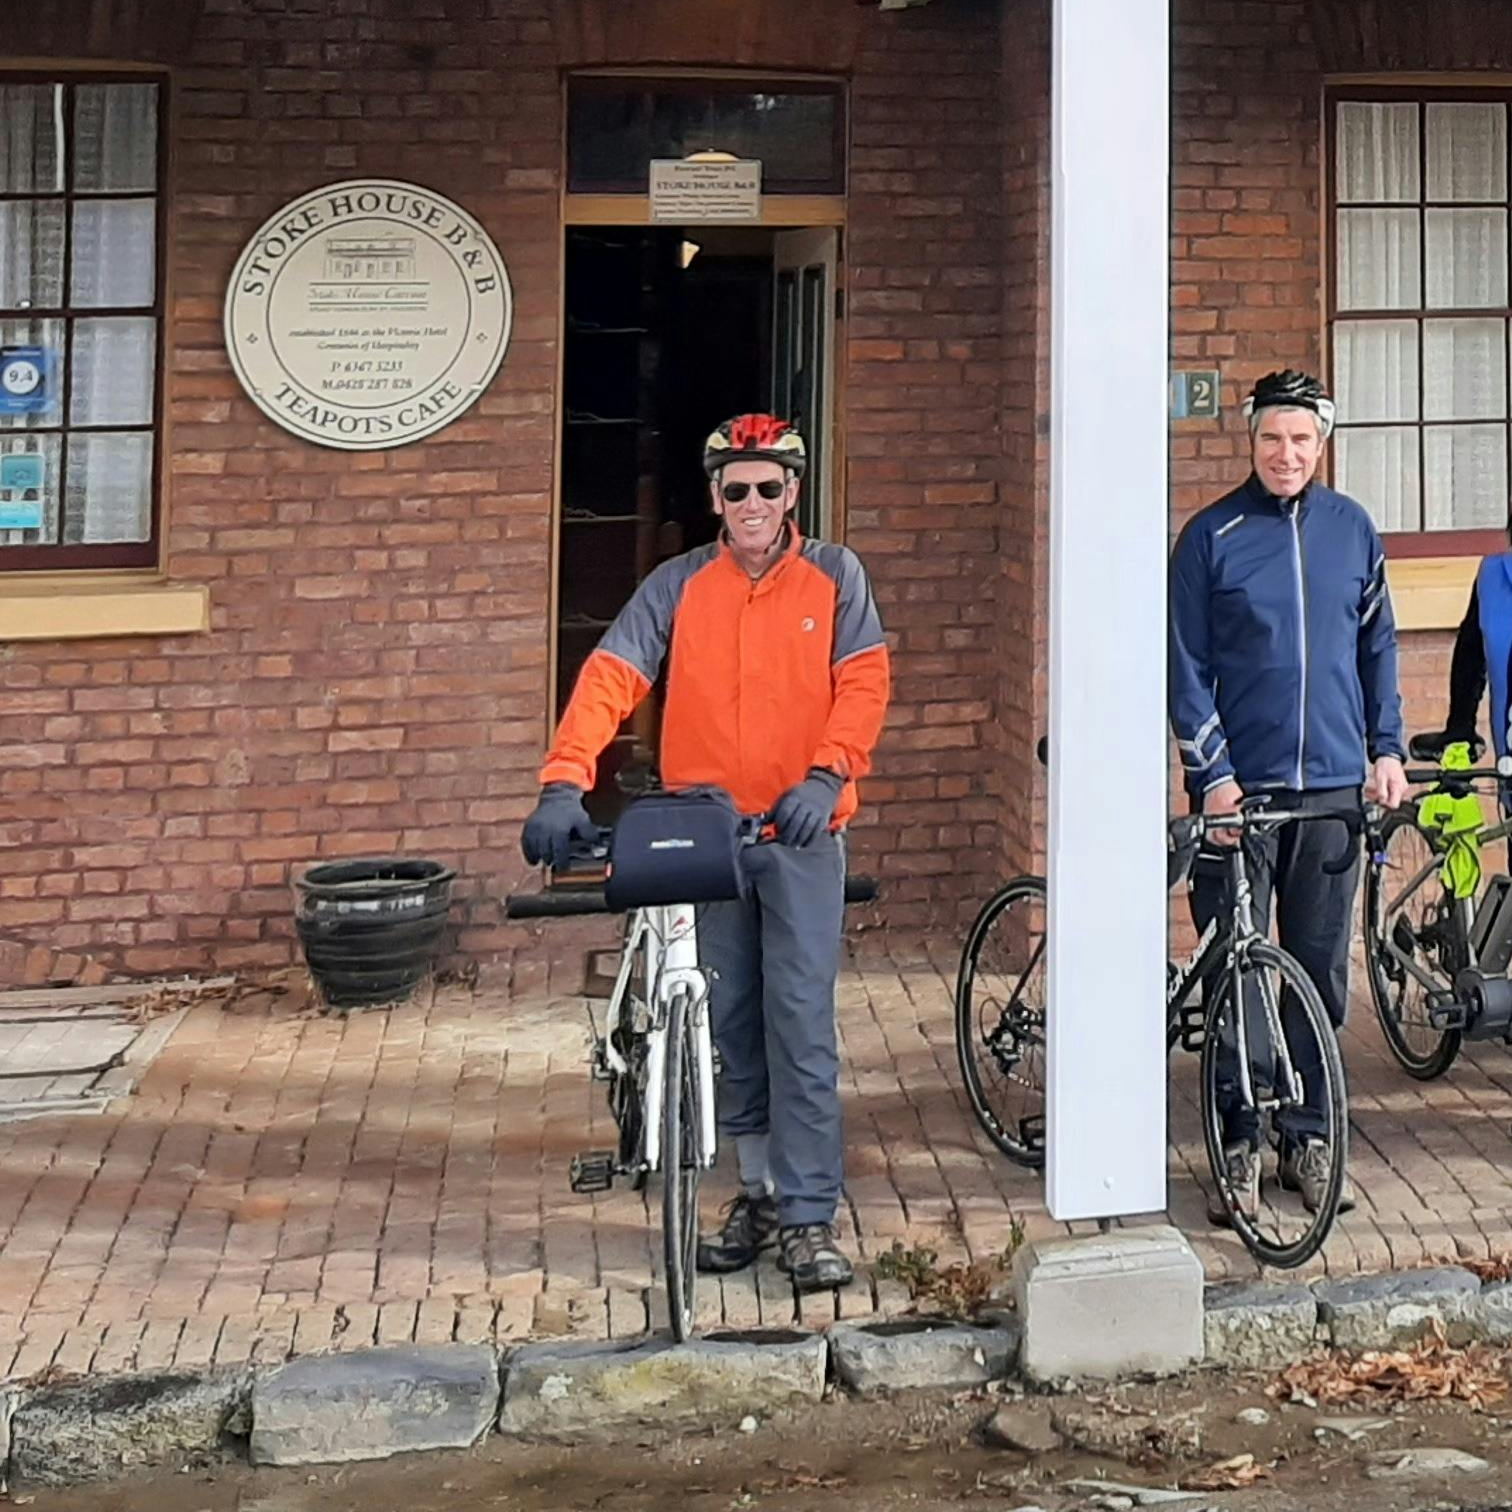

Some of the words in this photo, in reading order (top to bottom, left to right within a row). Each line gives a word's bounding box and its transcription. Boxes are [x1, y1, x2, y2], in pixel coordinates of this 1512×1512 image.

[243, 206, 324, 297] STOKE
[328, 192, 446, 229] HOUSE
[443, 223, 468, 245] B
[462, 249, 484, 268] &
[474, 273, 497, 294] B
[274, 382, 394, 435] TEAPOTS
[398, 381, 462, 427] CAFE
[1193, 380, 1209, 407] 2
